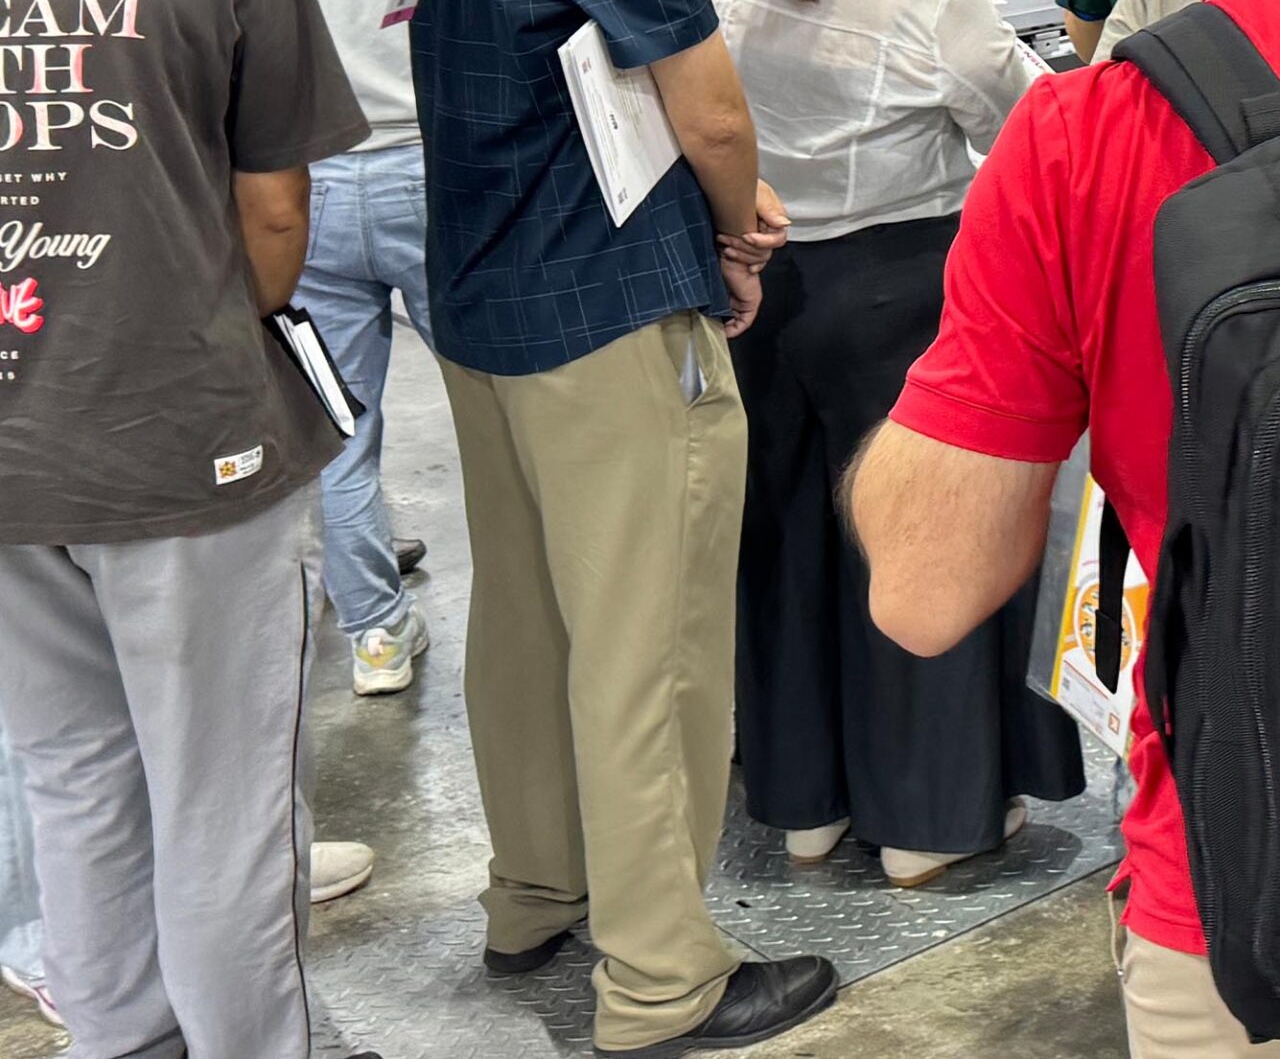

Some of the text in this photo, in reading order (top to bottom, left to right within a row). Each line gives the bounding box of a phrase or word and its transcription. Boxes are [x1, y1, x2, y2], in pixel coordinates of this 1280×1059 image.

[31, 172, 67, 183] WHY
[0, 196, 40, 205] RTED
[0, 220, 111, 273] Young
[0, 351, 19, 360] CE
